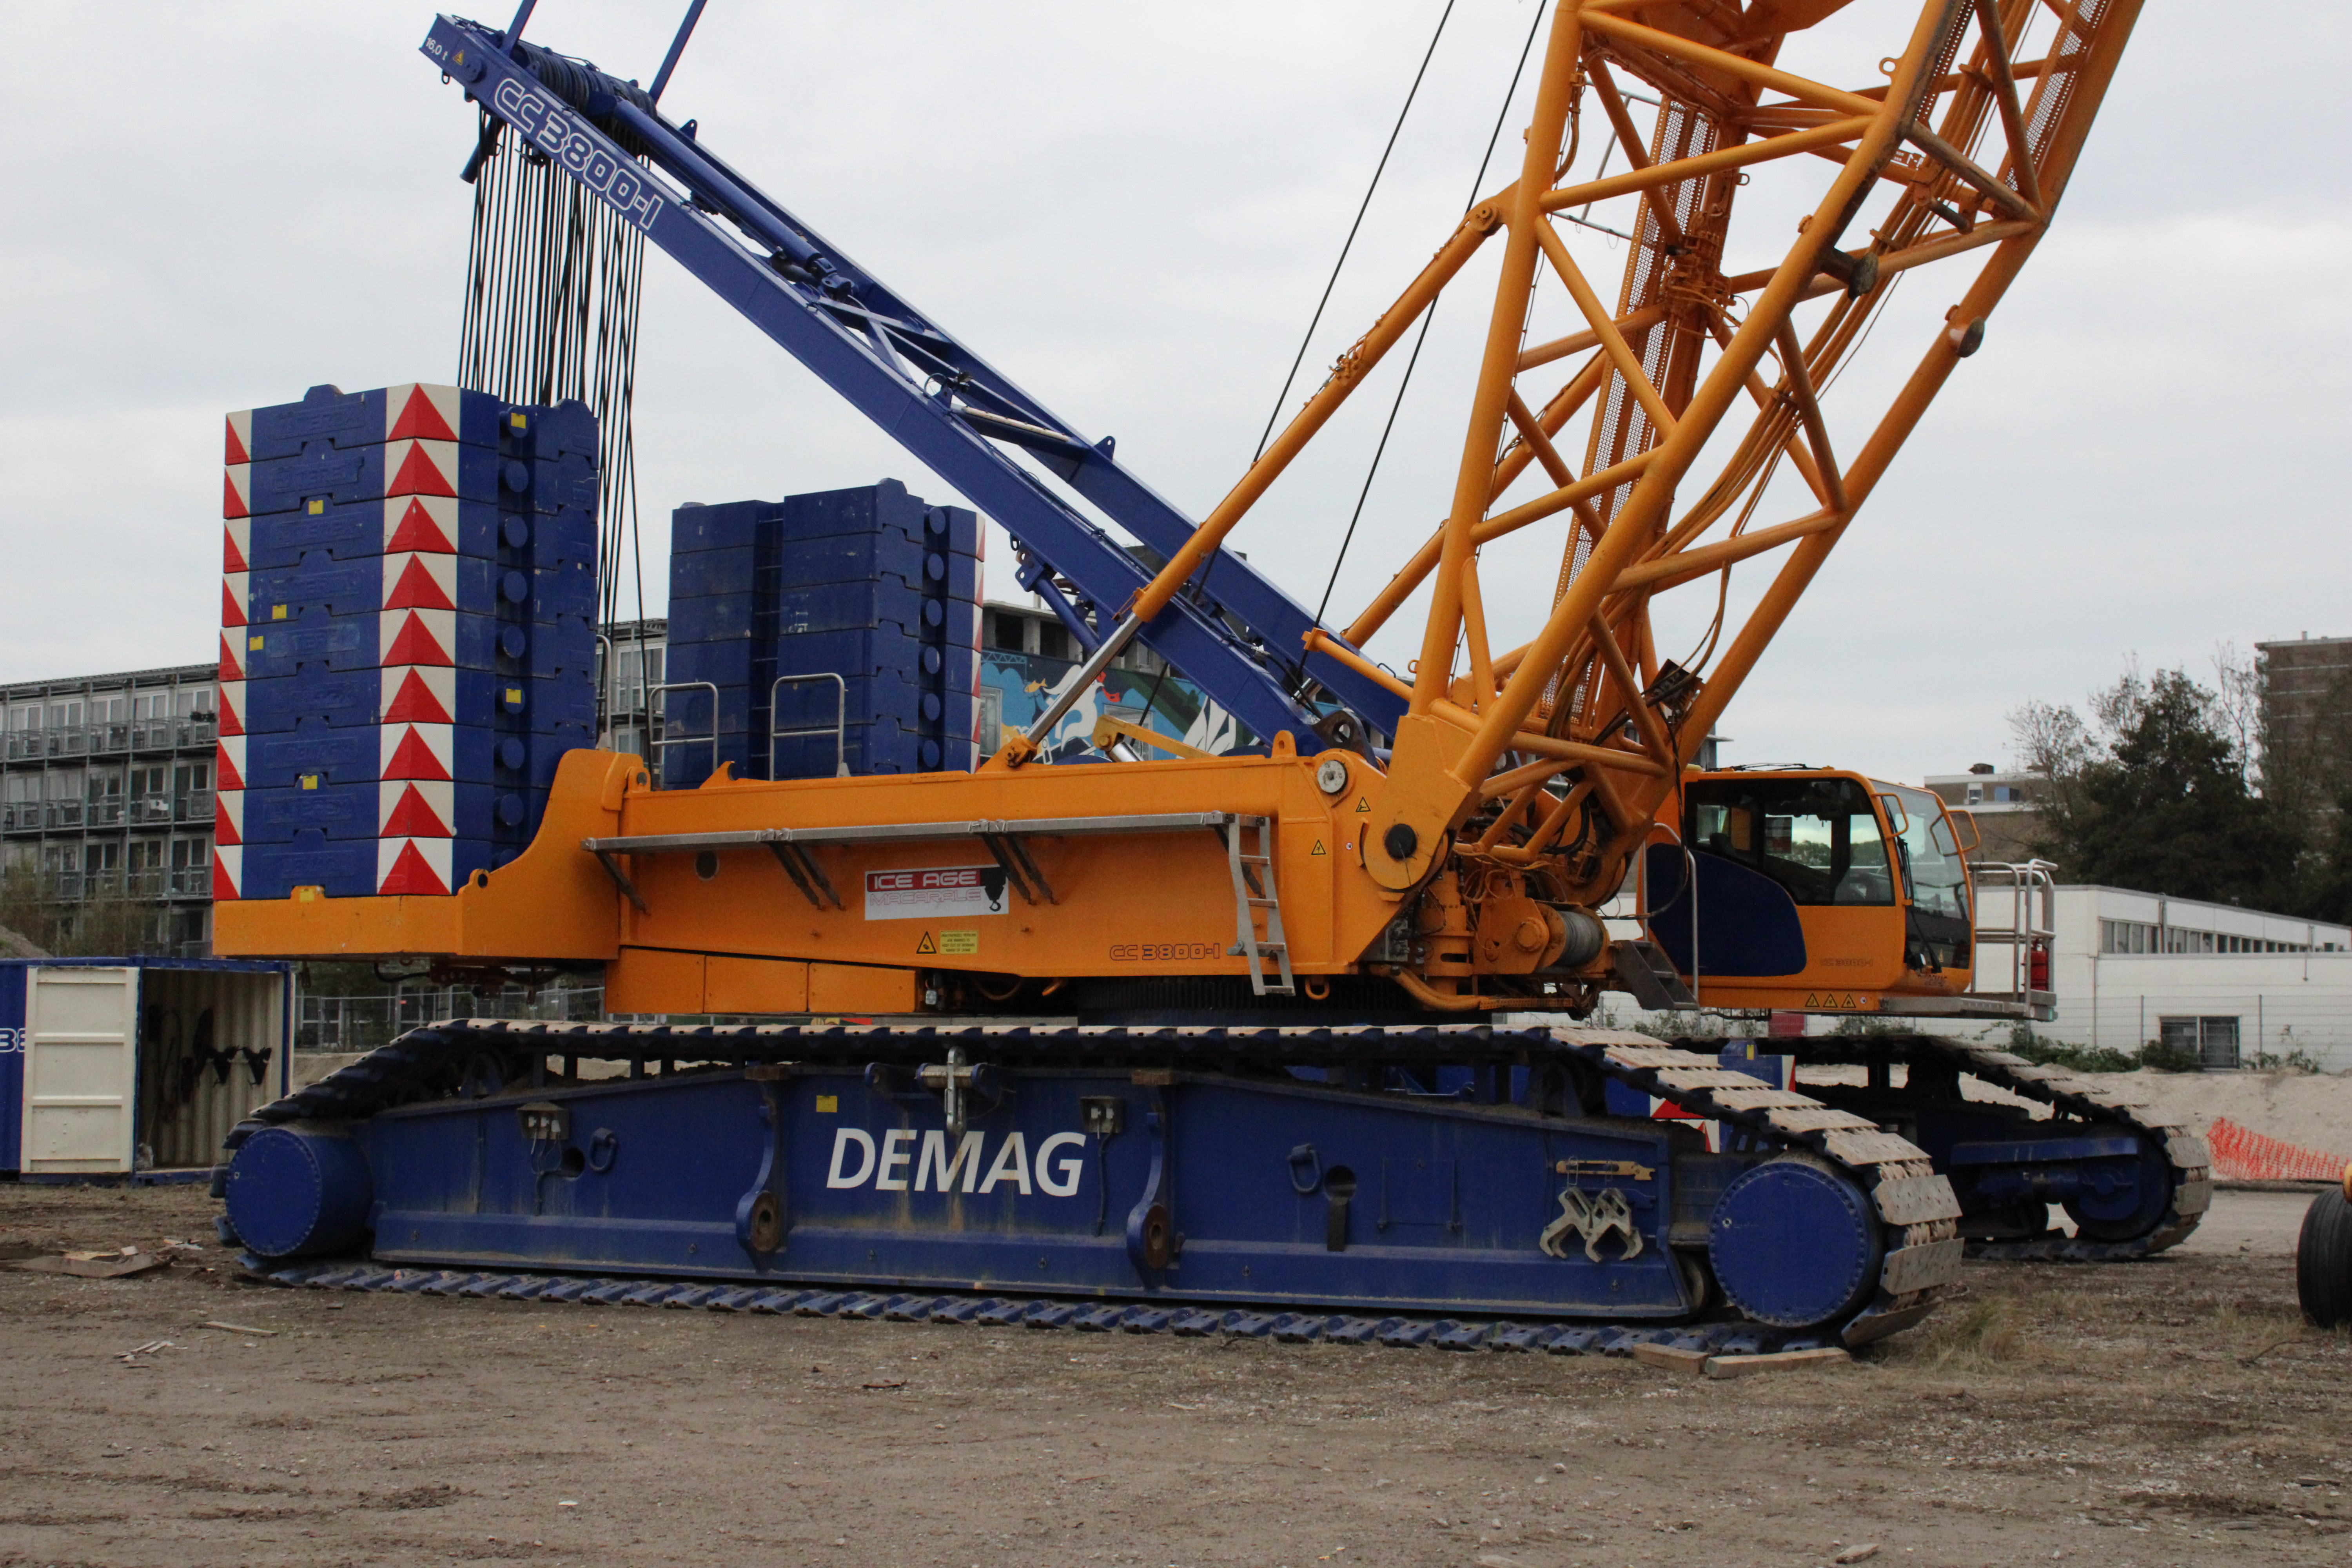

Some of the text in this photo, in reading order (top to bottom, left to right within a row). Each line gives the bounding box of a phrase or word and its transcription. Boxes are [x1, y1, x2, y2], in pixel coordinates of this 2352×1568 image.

[426, 37, 448, 61] 16,0 t
[494, 78, 545, 134] CC
[875, 871, 976, 889] ICE AGE
[870, 888, 981, 906] MACARALE
[1110, 945, 1138, 960] CC
[826, 1127, 1087, 1197] DEMAG
